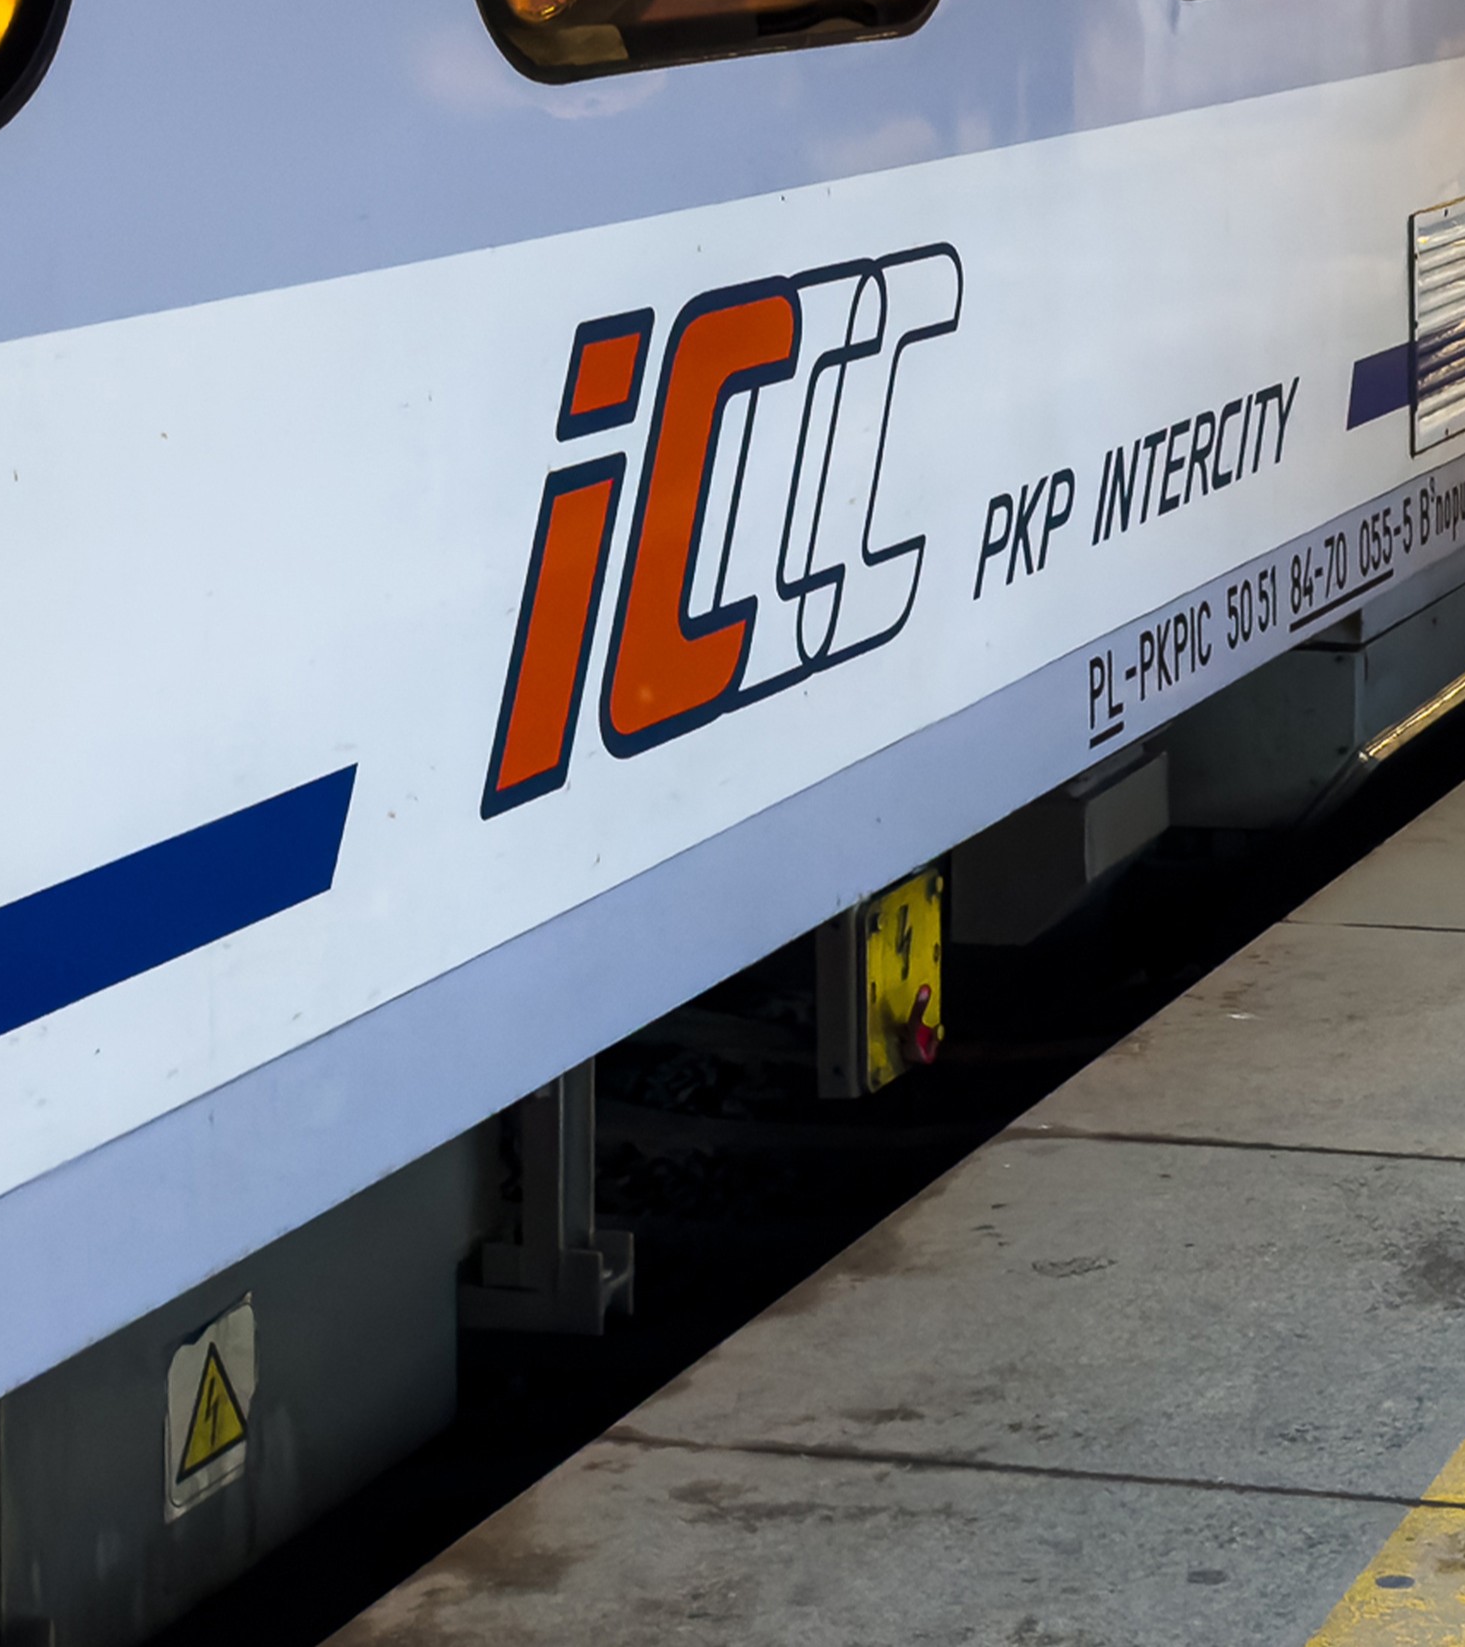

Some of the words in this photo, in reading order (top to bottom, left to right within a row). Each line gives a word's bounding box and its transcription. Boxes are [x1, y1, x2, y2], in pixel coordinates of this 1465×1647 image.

[973, 467, 1076, 601] PKP
[1092, 376, 1300, 547] INTERCITY
[1289, 531, 1347, 616] 84-70
[1359, 498, 1413, 578] 055-5
